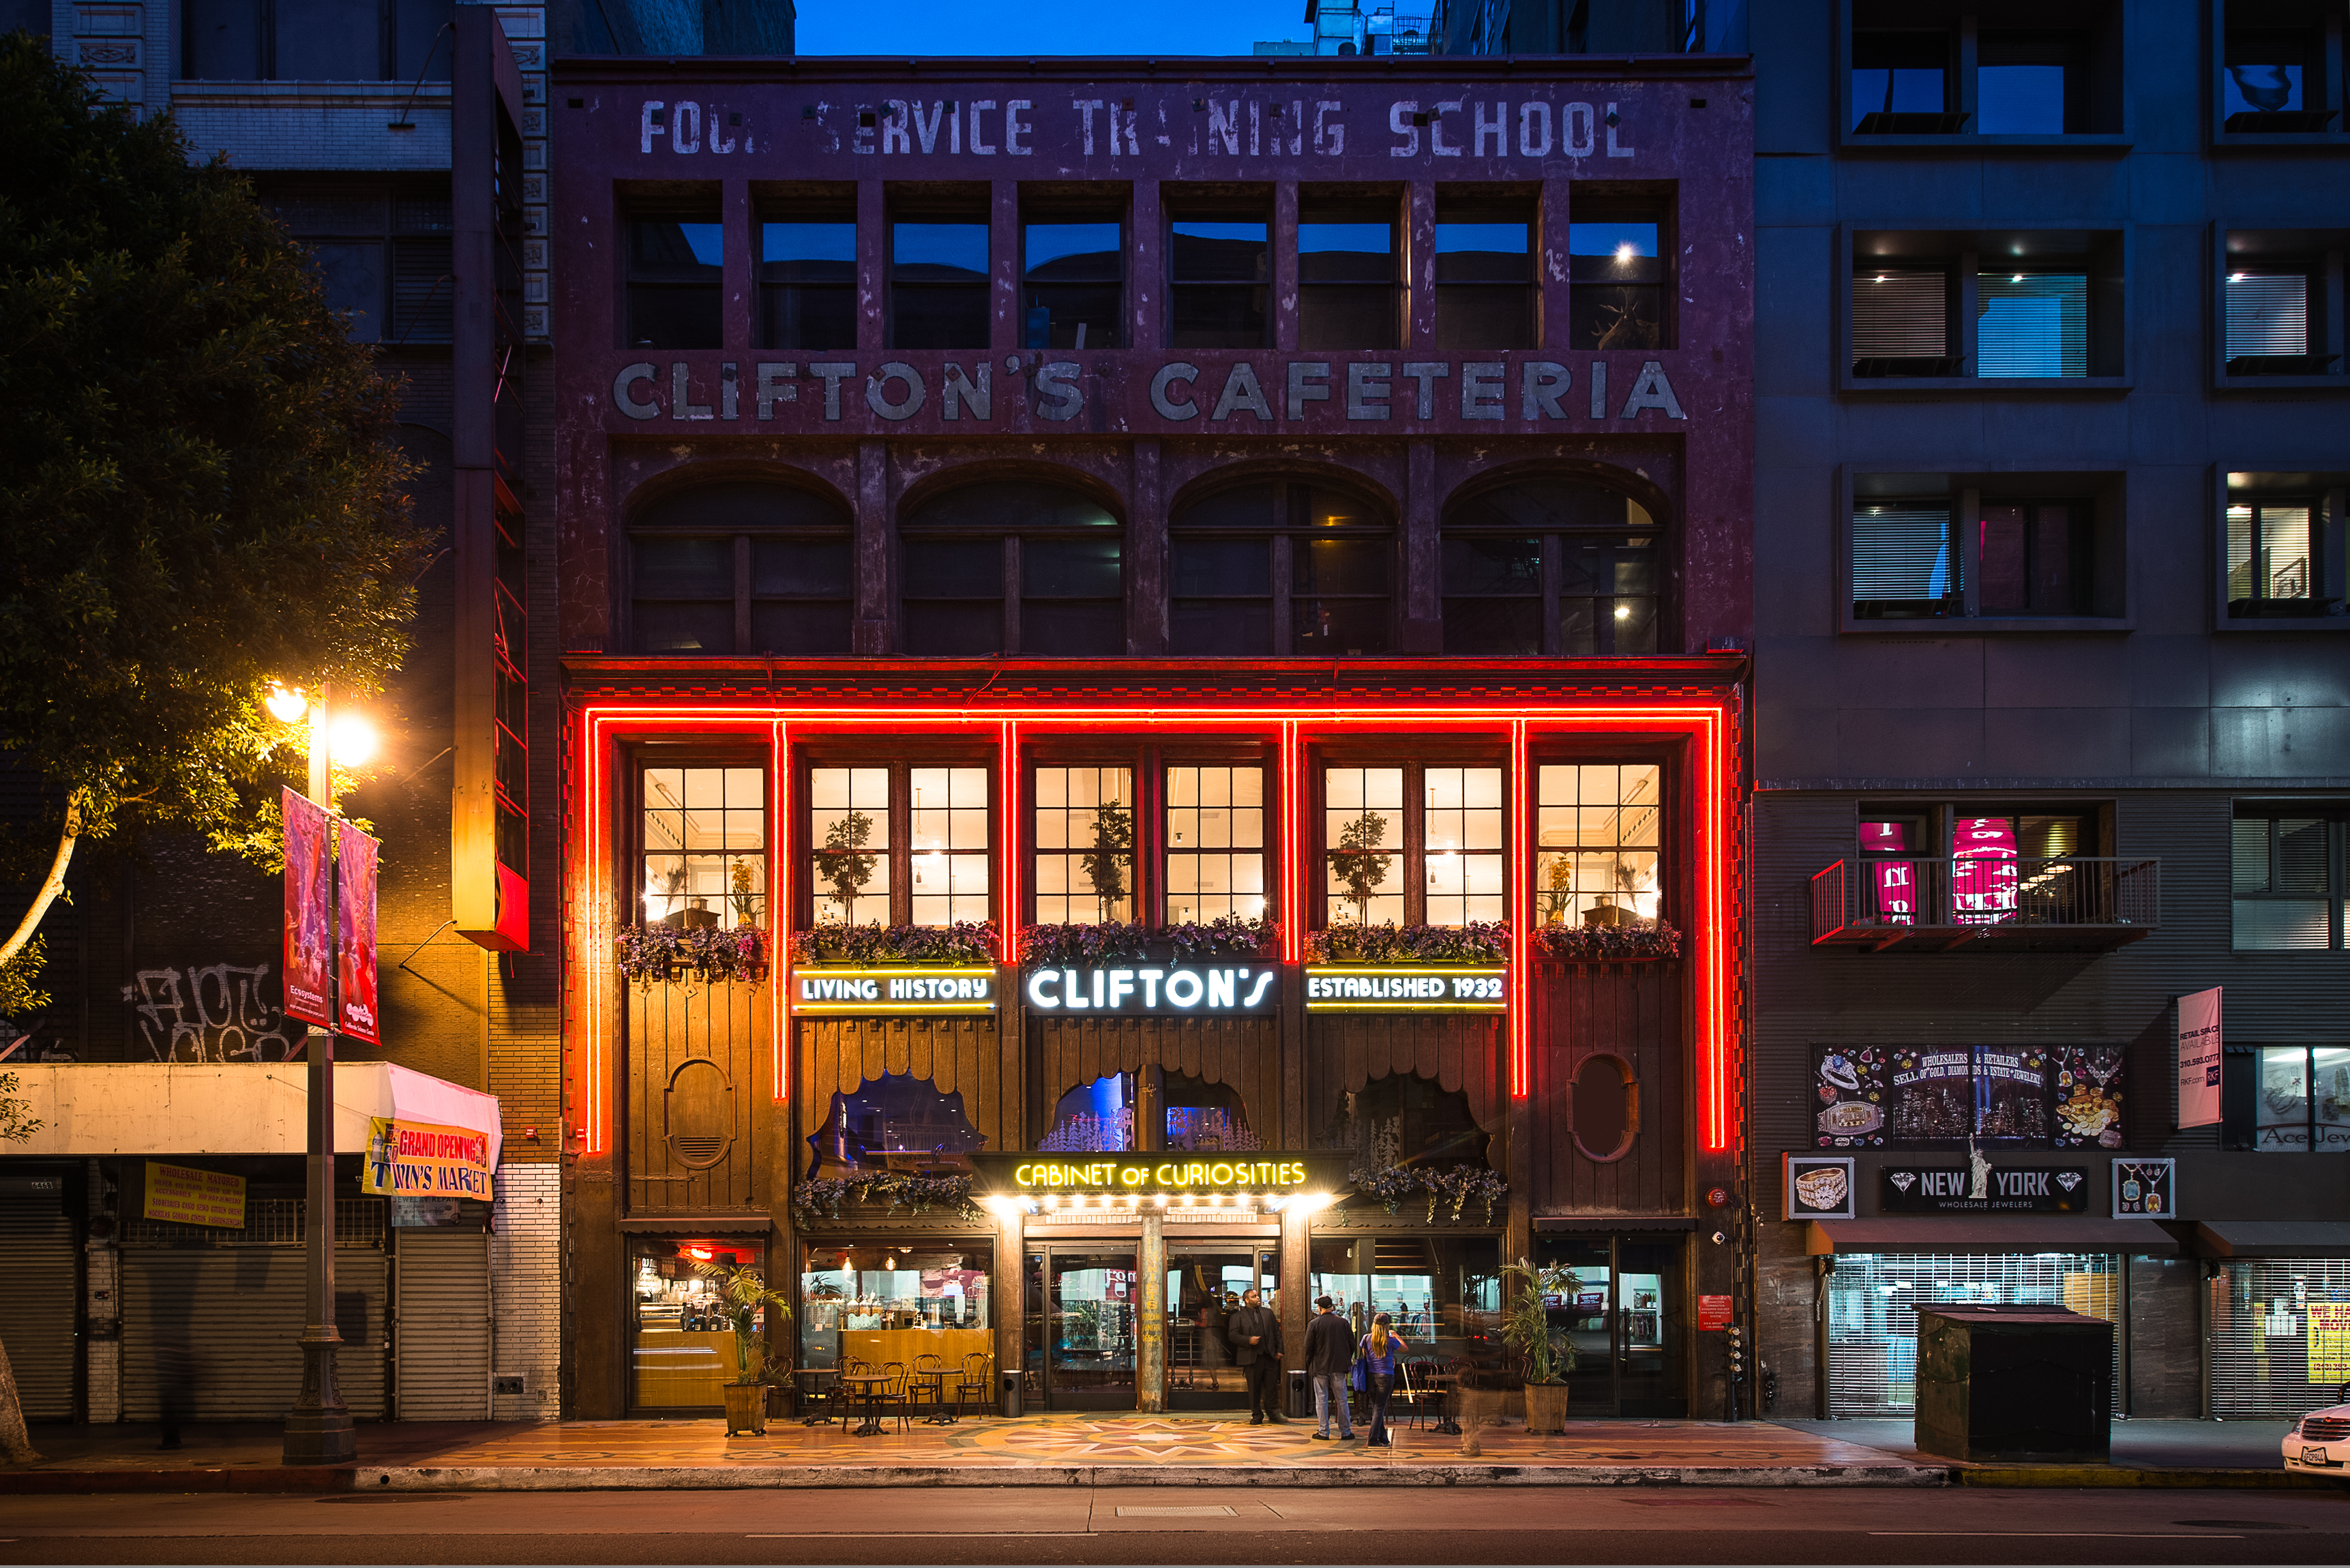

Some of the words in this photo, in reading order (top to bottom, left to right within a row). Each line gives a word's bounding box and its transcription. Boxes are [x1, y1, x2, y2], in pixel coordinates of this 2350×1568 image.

[1073, 99, 1345, 157] TRNING
[1390, 101, 1635, 157] SCHOOL
[612, 355, 1085, 421] CLIFTON'S
[1148, 359, 1688, 422] CAFETERIA
[290, 985, 323, 1004] Ecosystems
[802, 978, 878, 999] LIVING
[889, 978, 987, 999] HISTORY
[1028, 969, 1273, 1008] CLIFTON'S
[1308, 978, 1446, 997] ESTABLISHED
[1452, 978, 1503, 997] 1932
[2180, 1030, 2200, 1040] RETAIL
[2201, 1025, 2219, 1036] SPACE
[2180, 1034, 2219, 1051] AVAILABLE
[1922, 1053, 1968, 1068] WHOLESALERS
[1976, 1053, 1981, 1064] &
[1984, 1053, 2019, 1068] RETAILERS
[2180, 1053, 2219, 1068] 310.593.0777
[1893, 1071, 1918, 1085] SELL
[1920, 1068, 1929, 1079] OF
[1929, 1066, 1946, 1077] GOLD,
[1983, 1066, 1989, 1076] &
[1990, 1067, 2010, 1078] ESTATE
[2180, 1076, 2205, 1086] RKF.com
[2207, 1070, 2219, 1082] RKF
[399, 1130, 436, 1158] GRAND
[2262, 1126, 2308, 1143] Ace
[160, 1166, 203, 1181] WHOLESALE
[207, 1173, 239, 1187] MAYOREO
[370, 1161, 433, 1190] TWIN'S
[1015, 1163, 1117, 1186] CABINET
[1122, 1167, 1150, 1186] OF
[1157, 1162, 1306, 1186] CURIOSITIES
[1921, 1173, 1965, 1195] NEW
[1996, 1173, 2050, 1196] YORK
[155, 1188, 191, 1197] ACCESSORIES
[220, 1195, 241, 1205] JEWELRY
[182, 1202, 194, 1210] CASIO
[2310, 1306, 2330, 1317] WE
[2319, 1319, 2350, 1330] MOV
